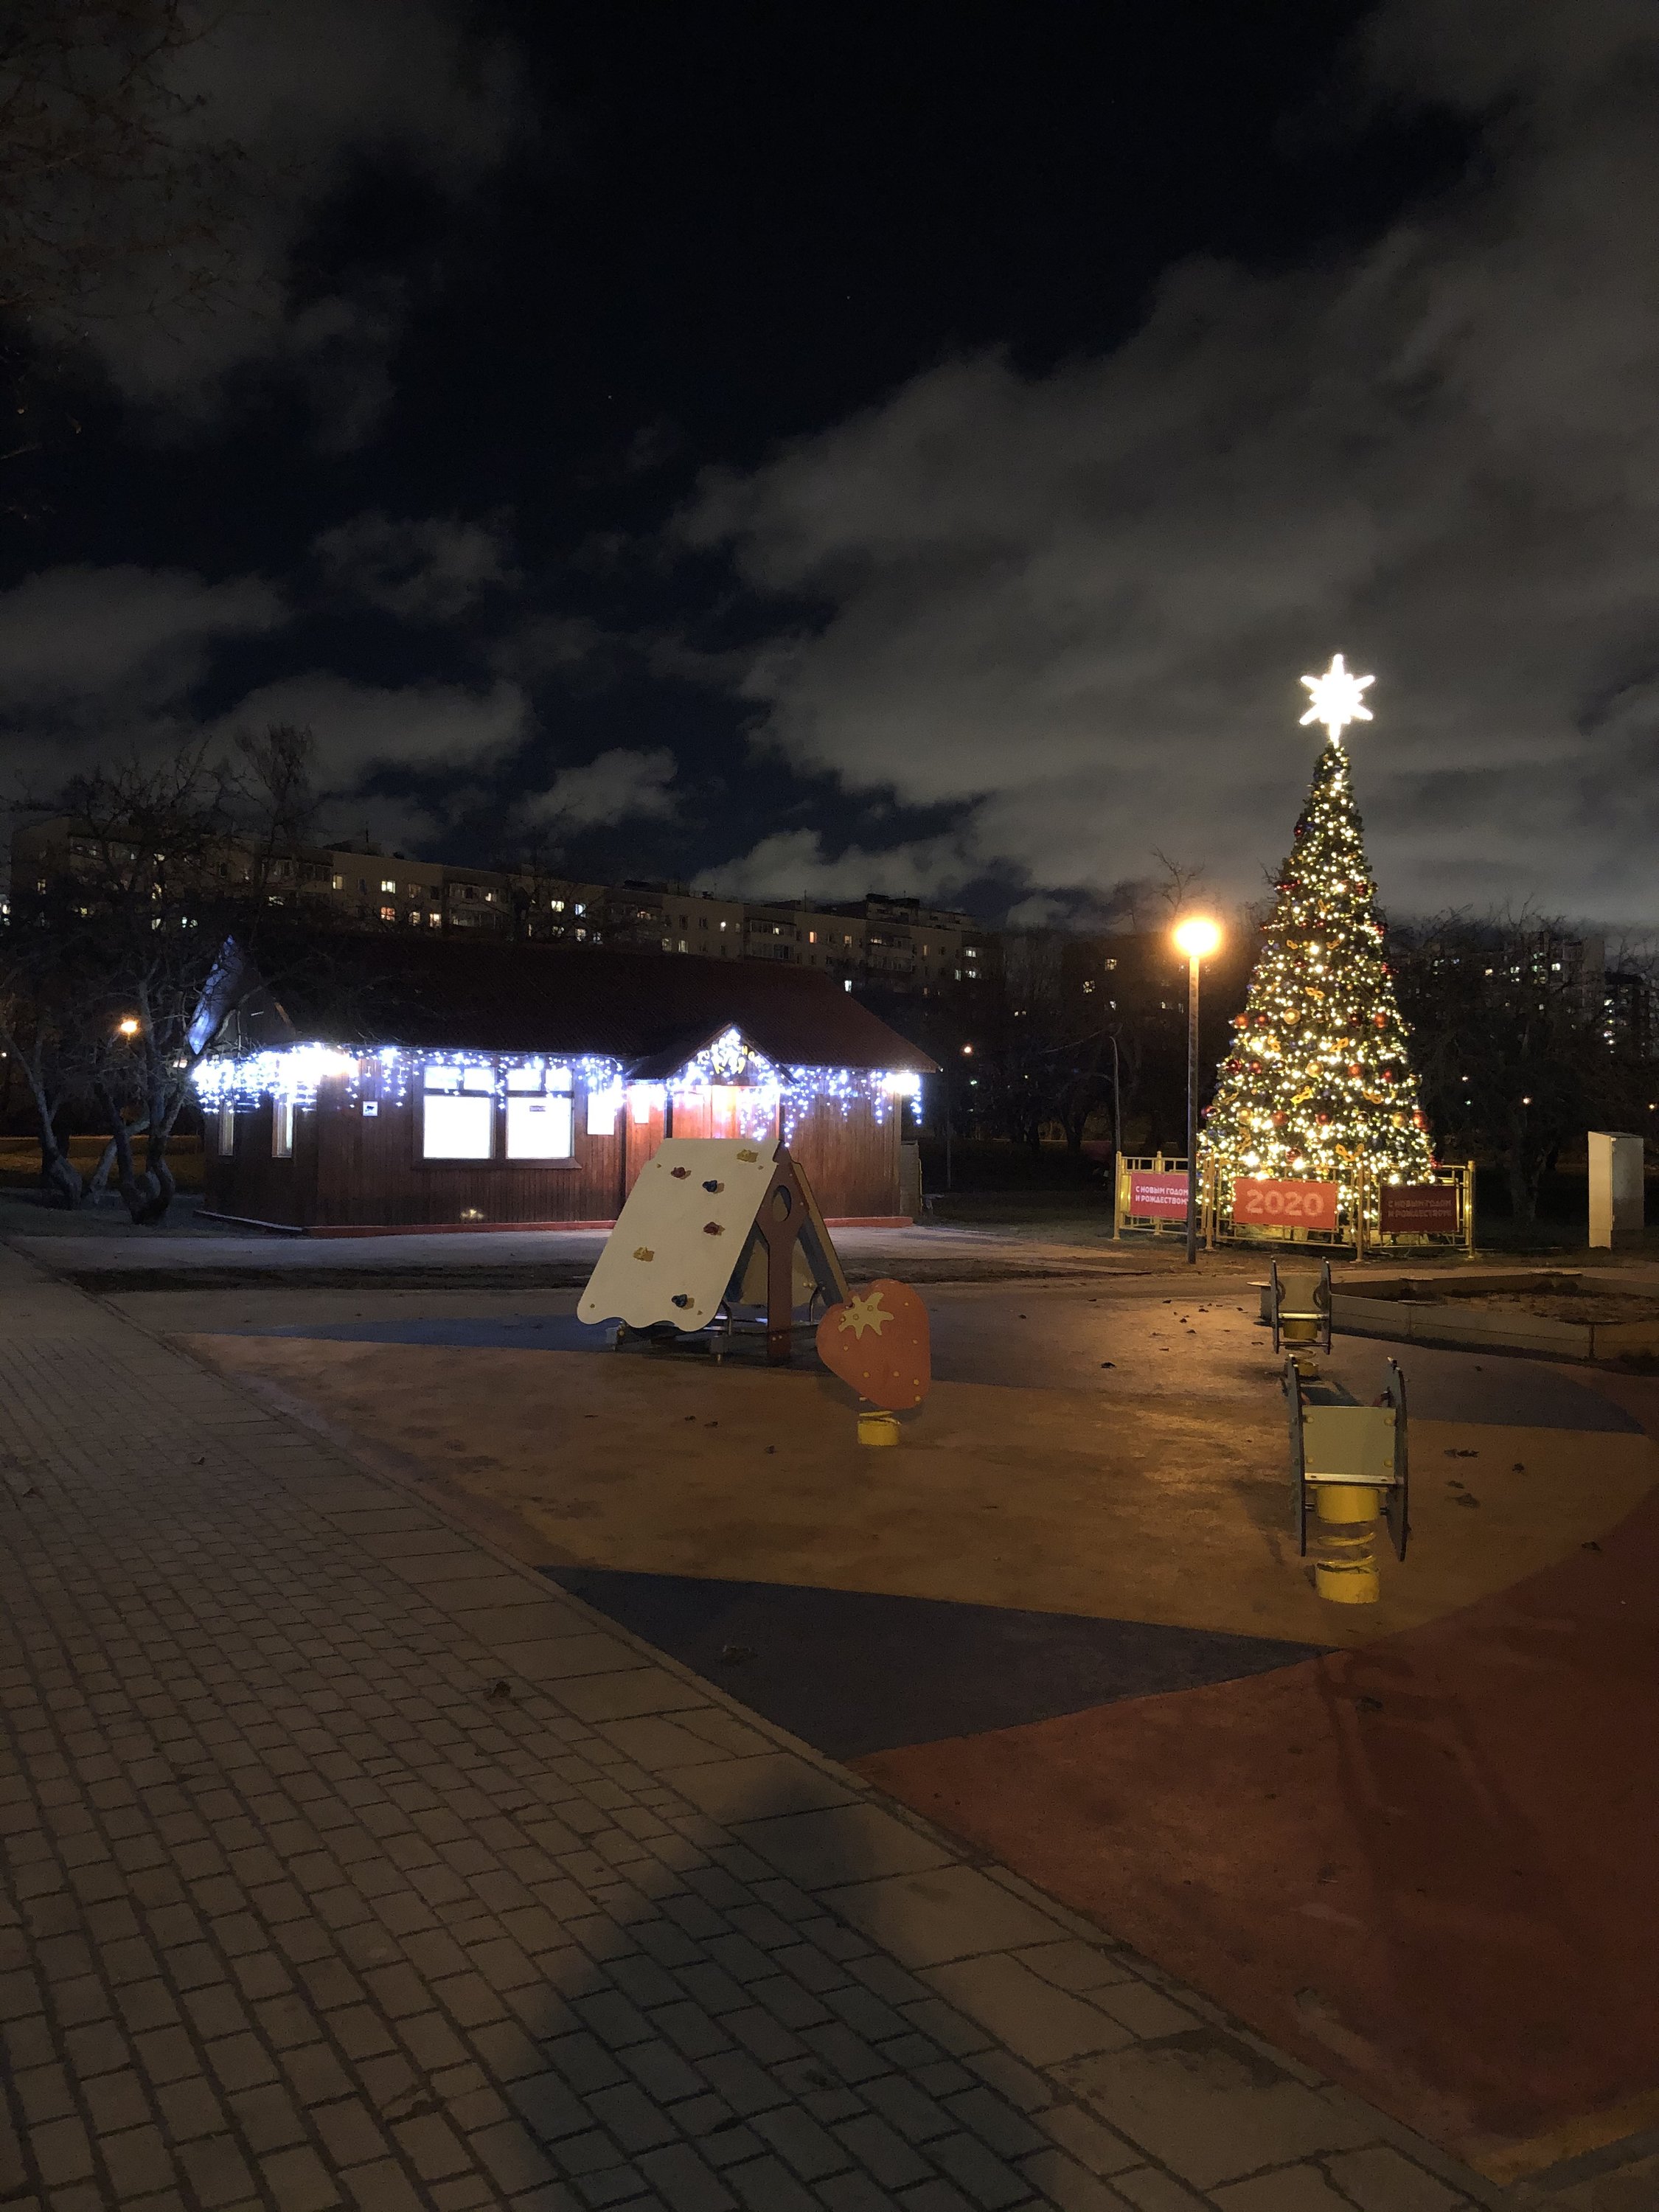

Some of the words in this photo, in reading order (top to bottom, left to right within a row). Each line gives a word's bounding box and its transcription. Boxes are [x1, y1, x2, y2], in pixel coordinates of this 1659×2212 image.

[1141, 1186, 1165, 1194] НОВЫМ
[1166, 1188, 1189, 1196] ГОДОМ
[1245, 1189, 1324, 1216] 2020
